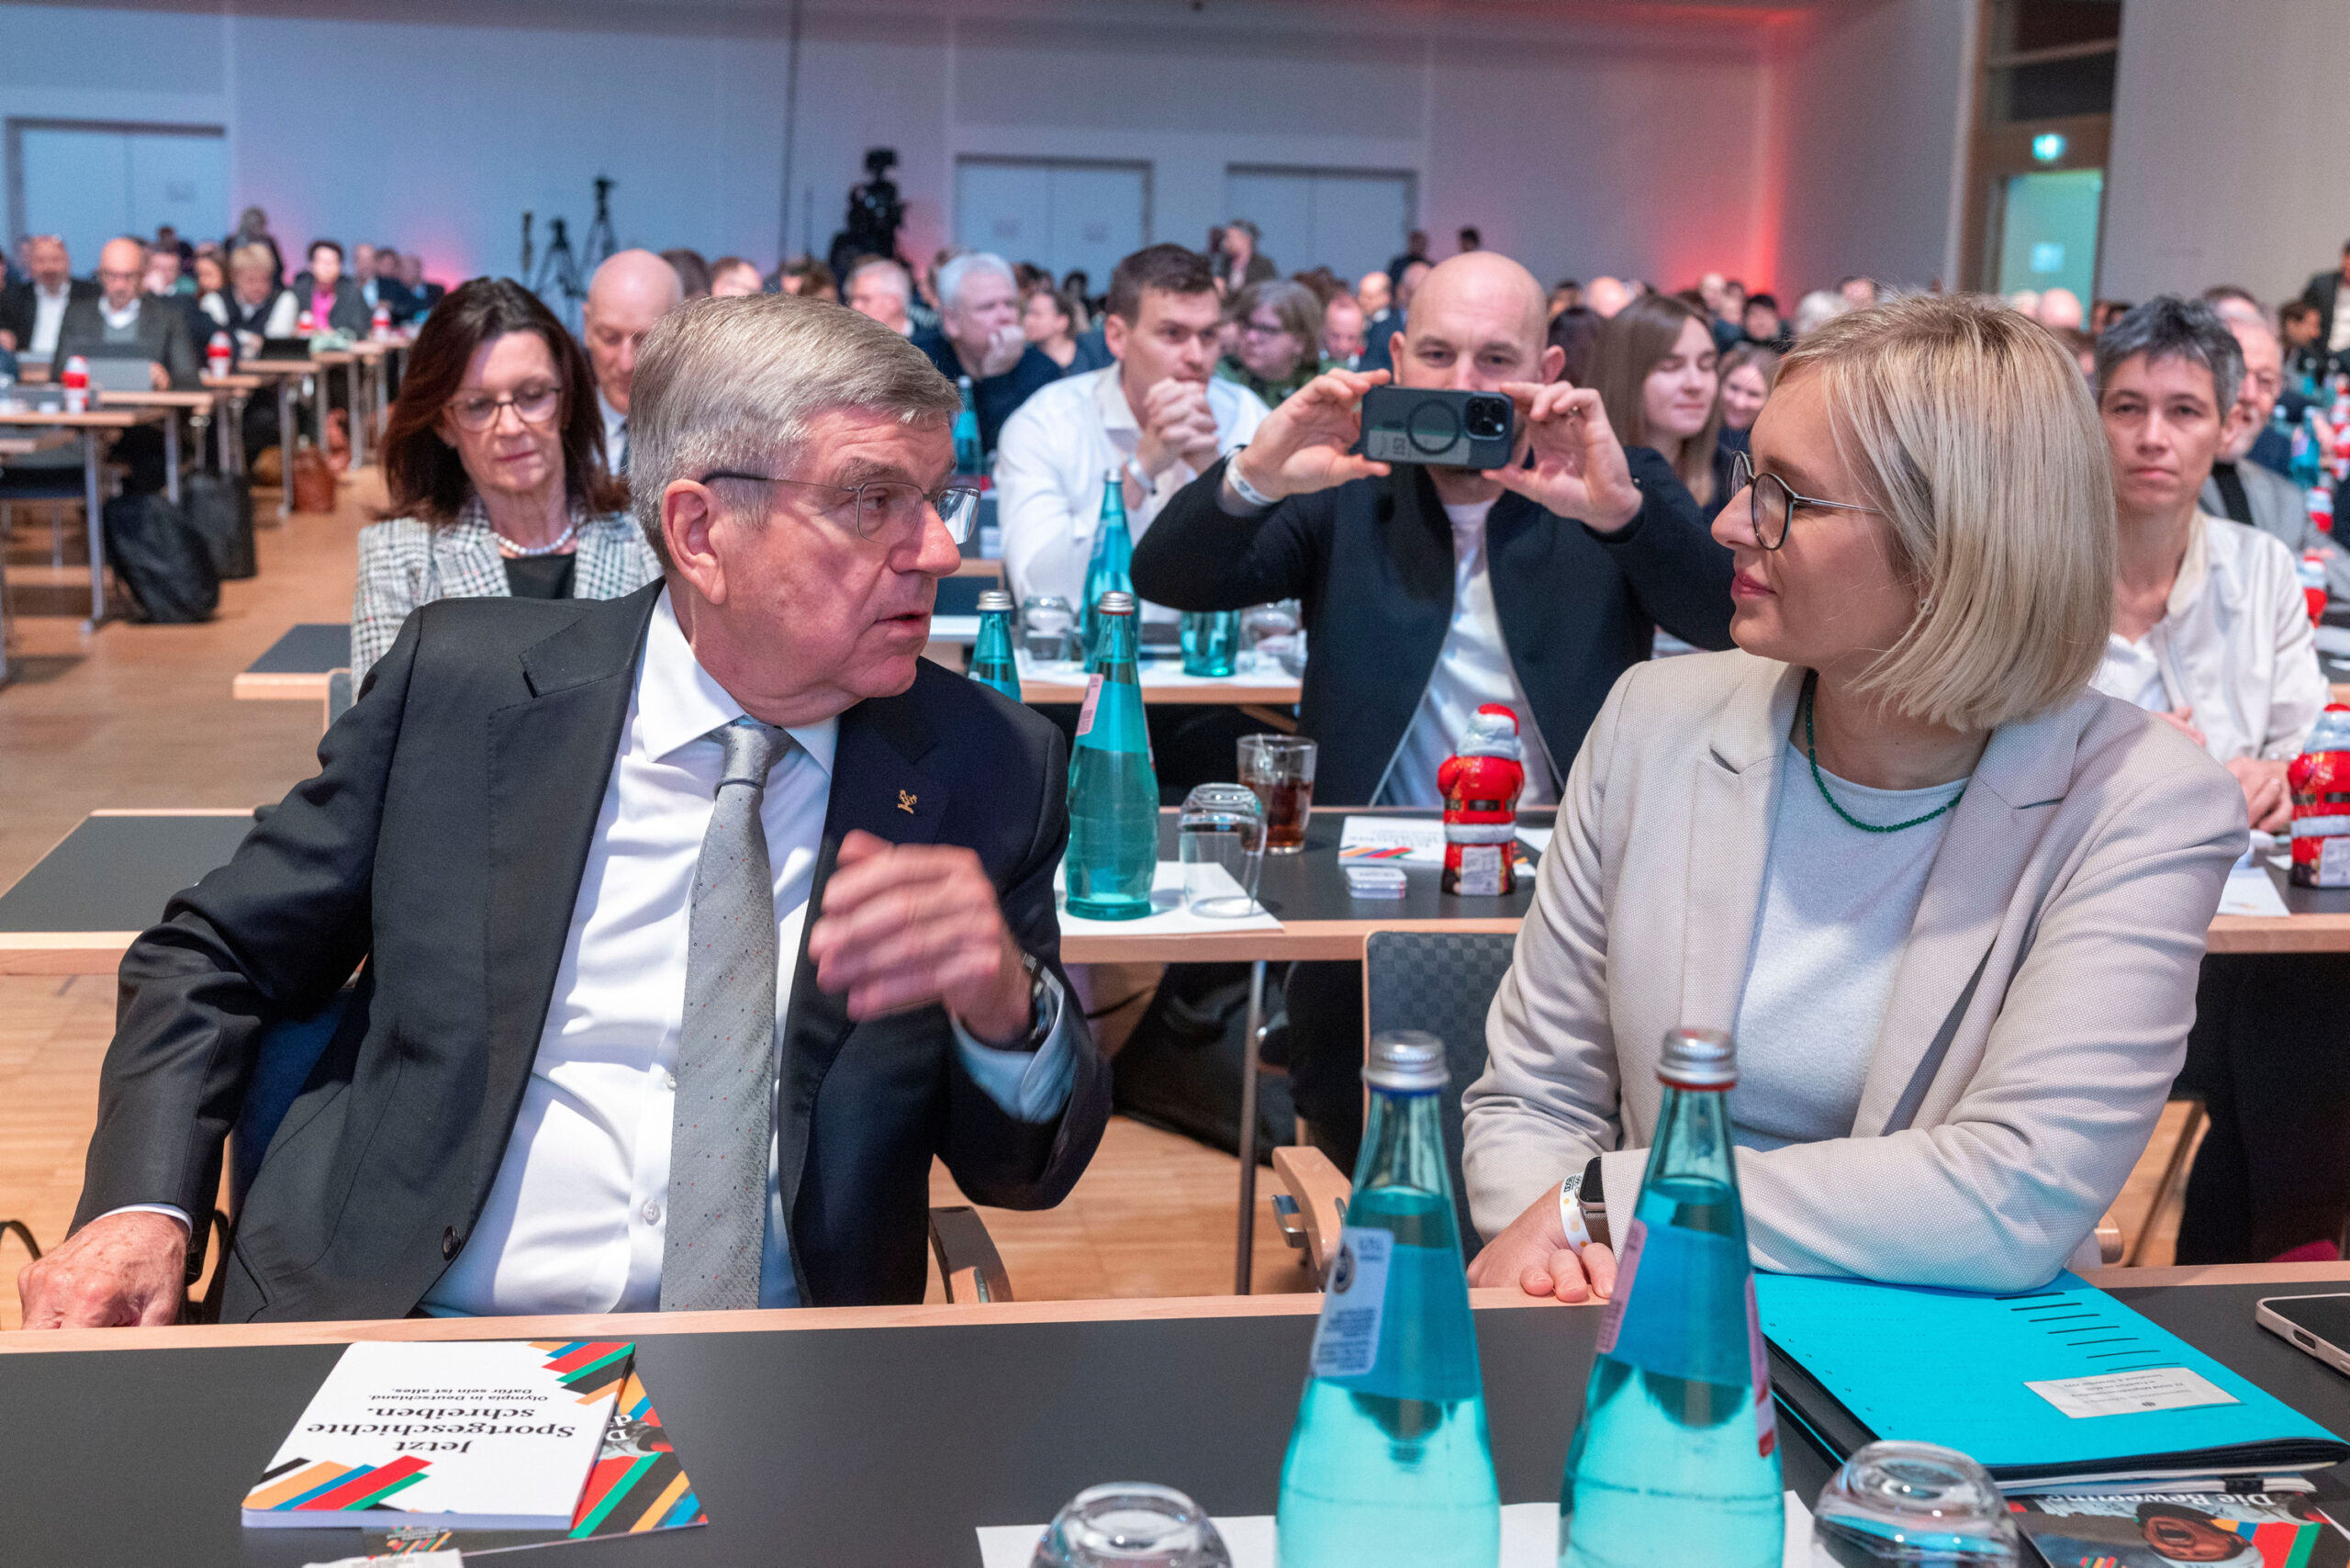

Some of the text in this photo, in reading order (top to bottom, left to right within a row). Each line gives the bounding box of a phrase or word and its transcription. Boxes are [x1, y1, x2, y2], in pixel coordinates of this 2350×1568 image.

[367, 1408, 535, 1420] schreiben.
[307, 1422, 576, 1438] Sportgeschichte
[395, 1440, 473, 1453] Jetzt
[2218, 1494, 2276, 1506] Die
